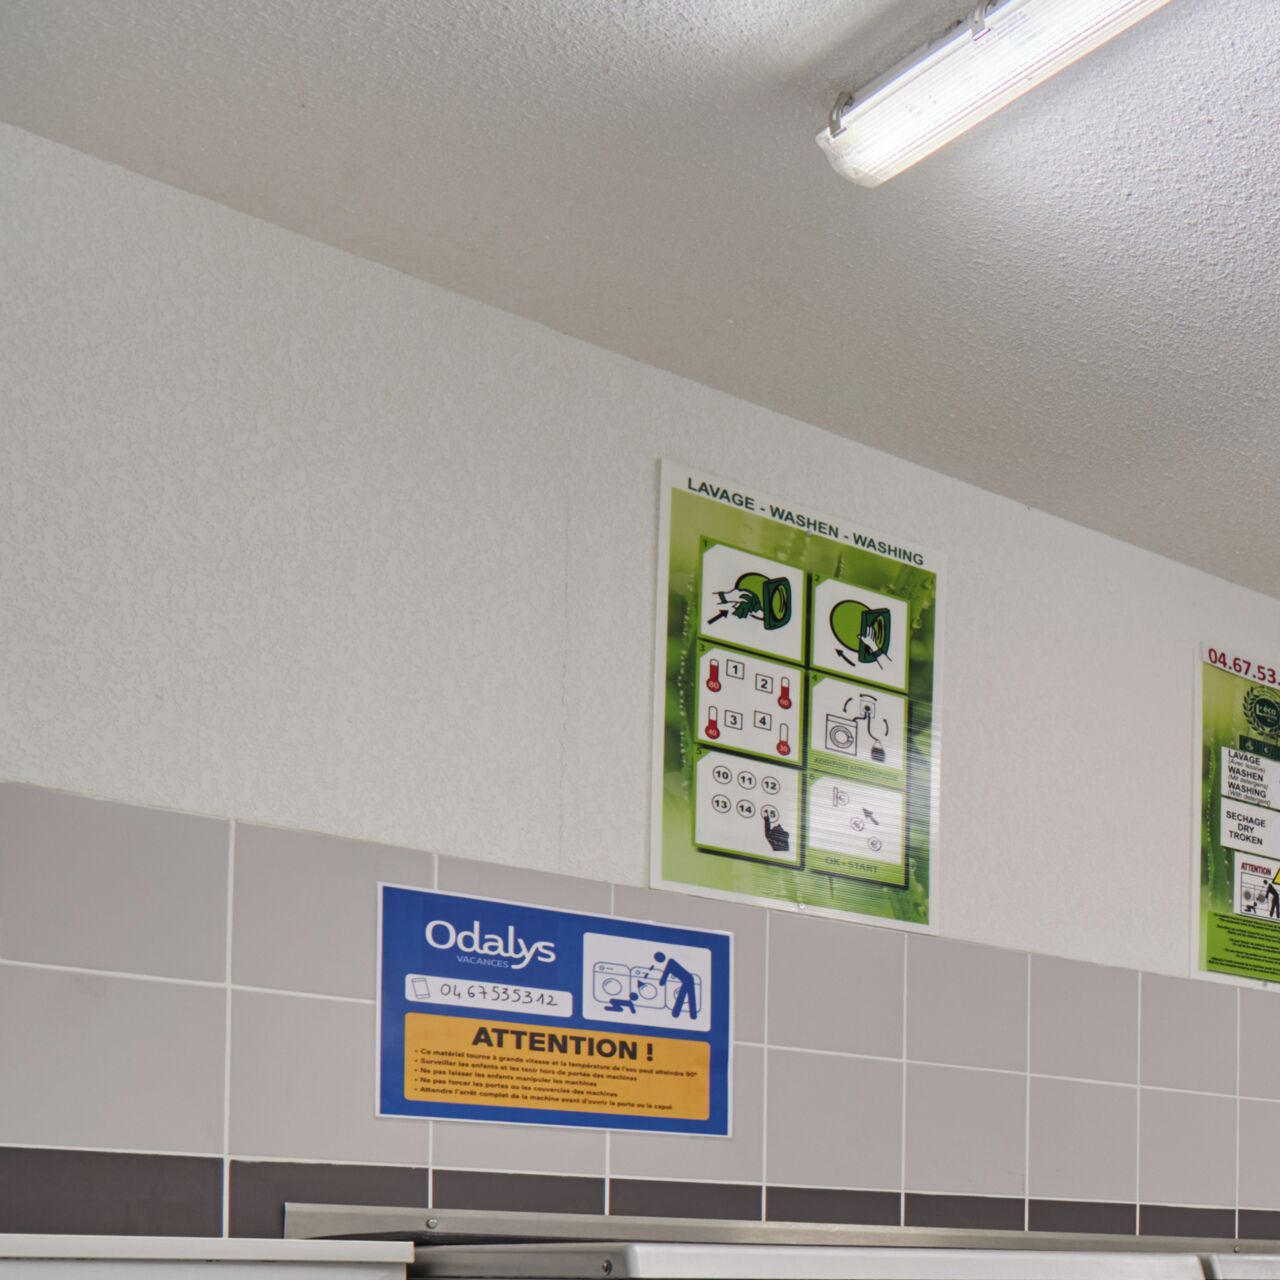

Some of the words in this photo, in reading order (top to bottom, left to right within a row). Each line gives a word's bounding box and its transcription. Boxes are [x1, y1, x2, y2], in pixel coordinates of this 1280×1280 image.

[688, 477, 755, 511] LAVAGE
[769, 504, 839, 538] WASHEN
[853, 532, 924, 566] WASHING
[732, 665, 738, 675] 1
[708, 680, 719, 689] 80
[760, 678, 768, 689] 2
[730, 715, 738, 726] 3
[759, 716, 766, 727] 4
[1228, 749, 1261, 766] LAVAGE
[715, 770, 729, 780] 10
[1228, 765, 1263, 781] WASHEN
[740, 776, 753, 785] 11
[764, 781, 777, 790] 12
[1228, 781, 1267, 798] WASHING
[714, 799, 728, 809] 13
[739, 804, 752, 814] 14
[1226, 810, 1266, 828] SECHAGE
[1238, 823, 1254, 833] DRY
[1229, 830, 1263, 845] TROKEN
[1241, 862, 1272, 876] ATTENTION
[425, 919, 557, 969] Odalys
[456, 955, 510, 969] VACANCES
[472, 1026, 638, 1061] ATTENTION
[646, 1043, 654, 1063] !
[499, 1055, 523, 1064] grande
[526, 1058, 549, 1066] vitesse
[420, 1058, 456, 1067] Surveiller
[471, 1062, 498, 1070] enfants
[606, 1073, 637, 1082] machines
[487, 1072, 514, 1081] enfants
[565, 1079, 597, 1087] machines
[420, 1086, 452, 1095] Attendre
[479, 1090, 508, 1099] complet
[529, 1094, 559, 1102] machine
[448, 1079, 470, 1087] forcer
[485, 1082, 508, 1090] portes
[586, 1090, 618, 1098] machines
